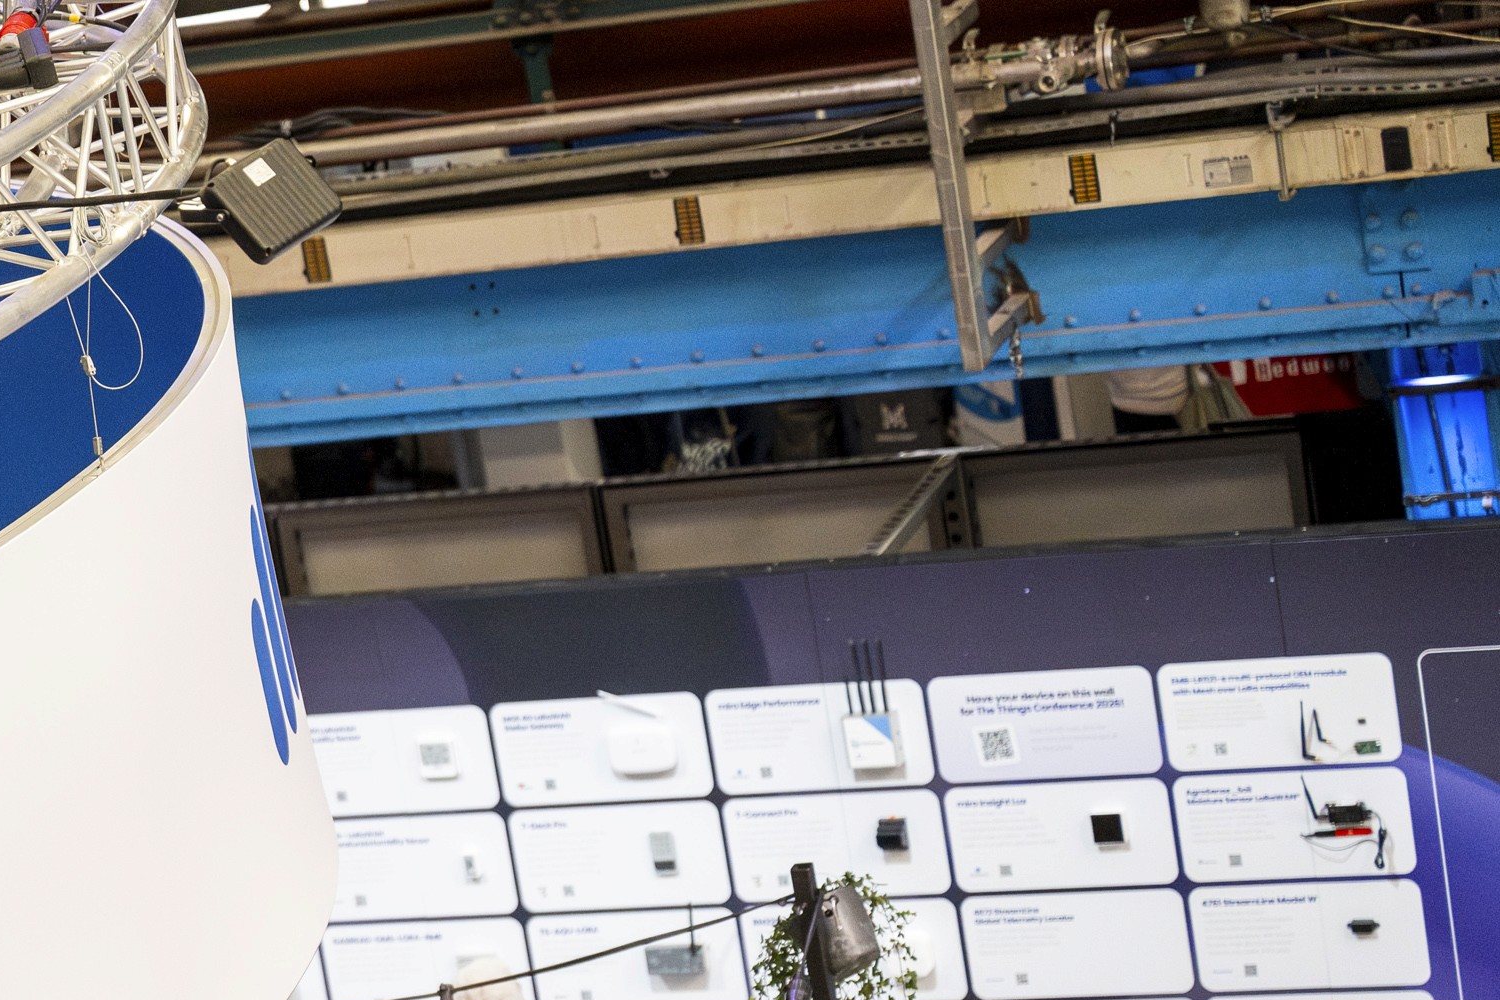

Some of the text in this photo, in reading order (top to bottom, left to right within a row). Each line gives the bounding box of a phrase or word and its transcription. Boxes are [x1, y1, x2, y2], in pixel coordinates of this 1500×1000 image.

[1021, 690, 1055, 700] device
[997, 704, 1031, 716] Things
[1033, 701, 1093, 712] Conference
